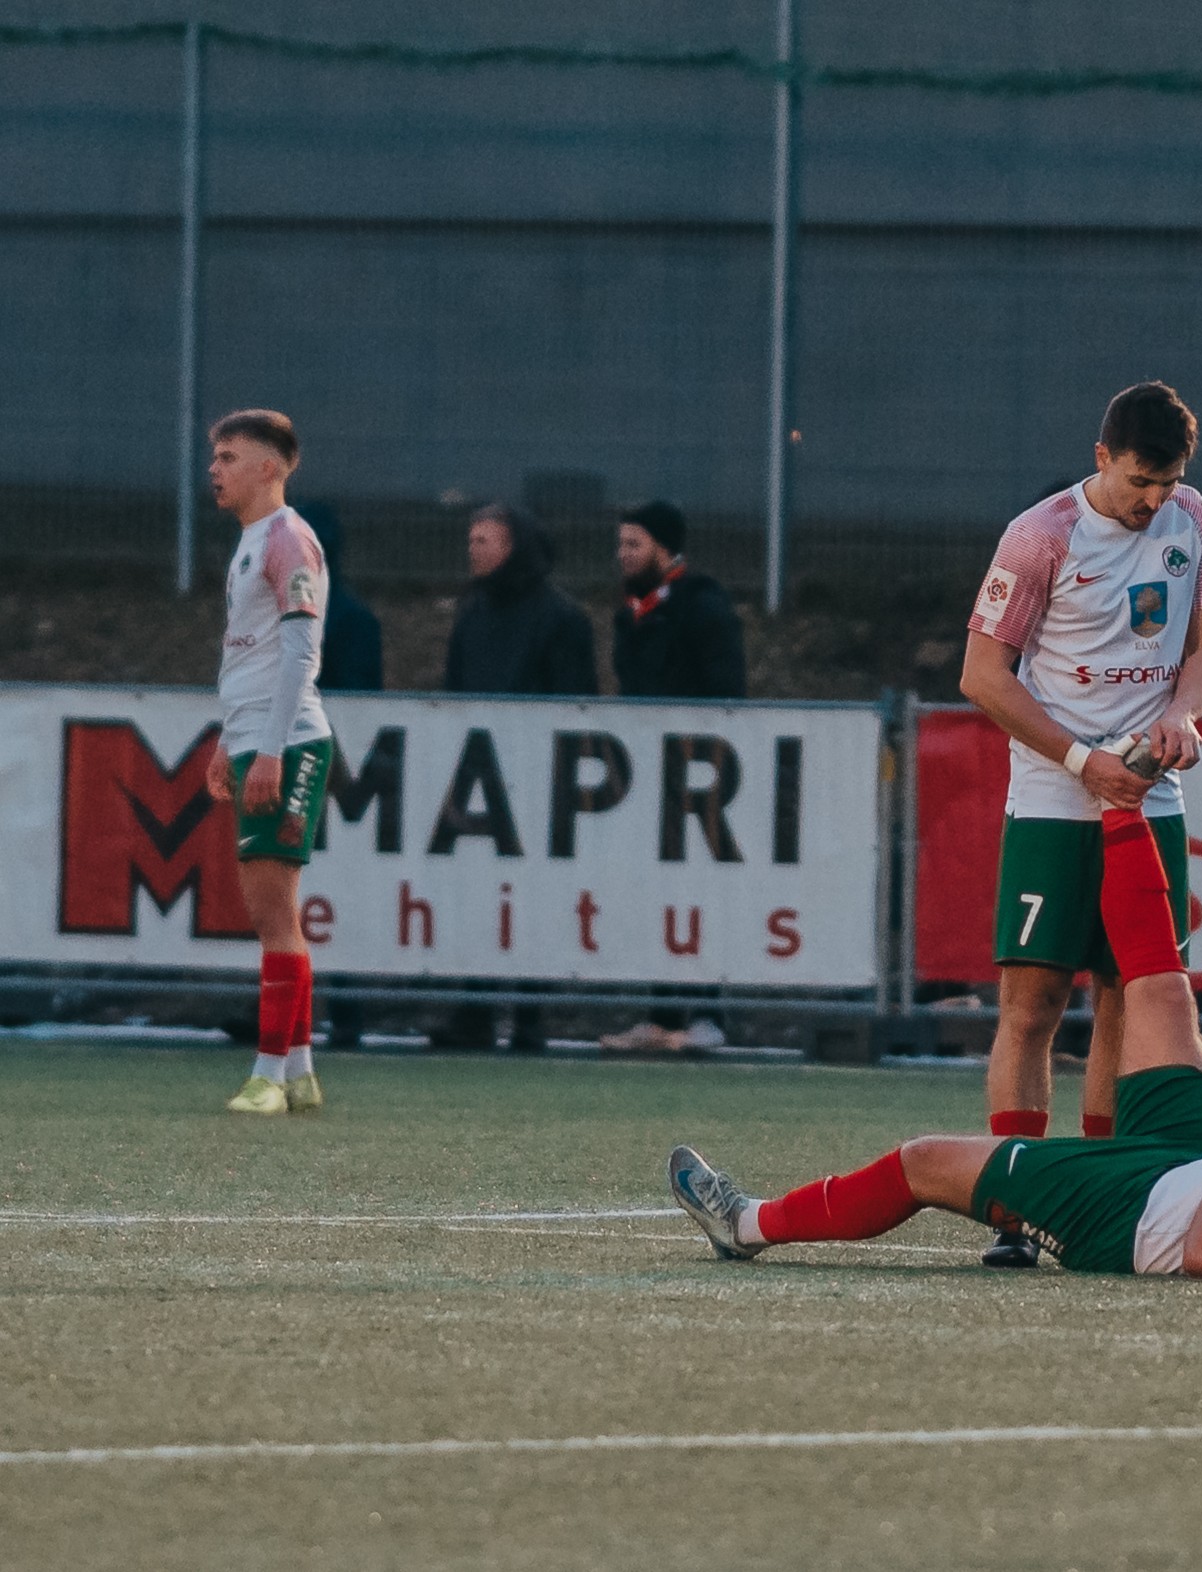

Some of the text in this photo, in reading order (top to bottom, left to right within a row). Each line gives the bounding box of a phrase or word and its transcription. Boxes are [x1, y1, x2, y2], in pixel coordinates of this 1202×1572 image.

[1135, 640, 1160, 651] ELVA
[313, 726, 802, 863] MAPRI
[301, 880, 801, 957] ehitus
[1020, 893, 1043, 946] 7
